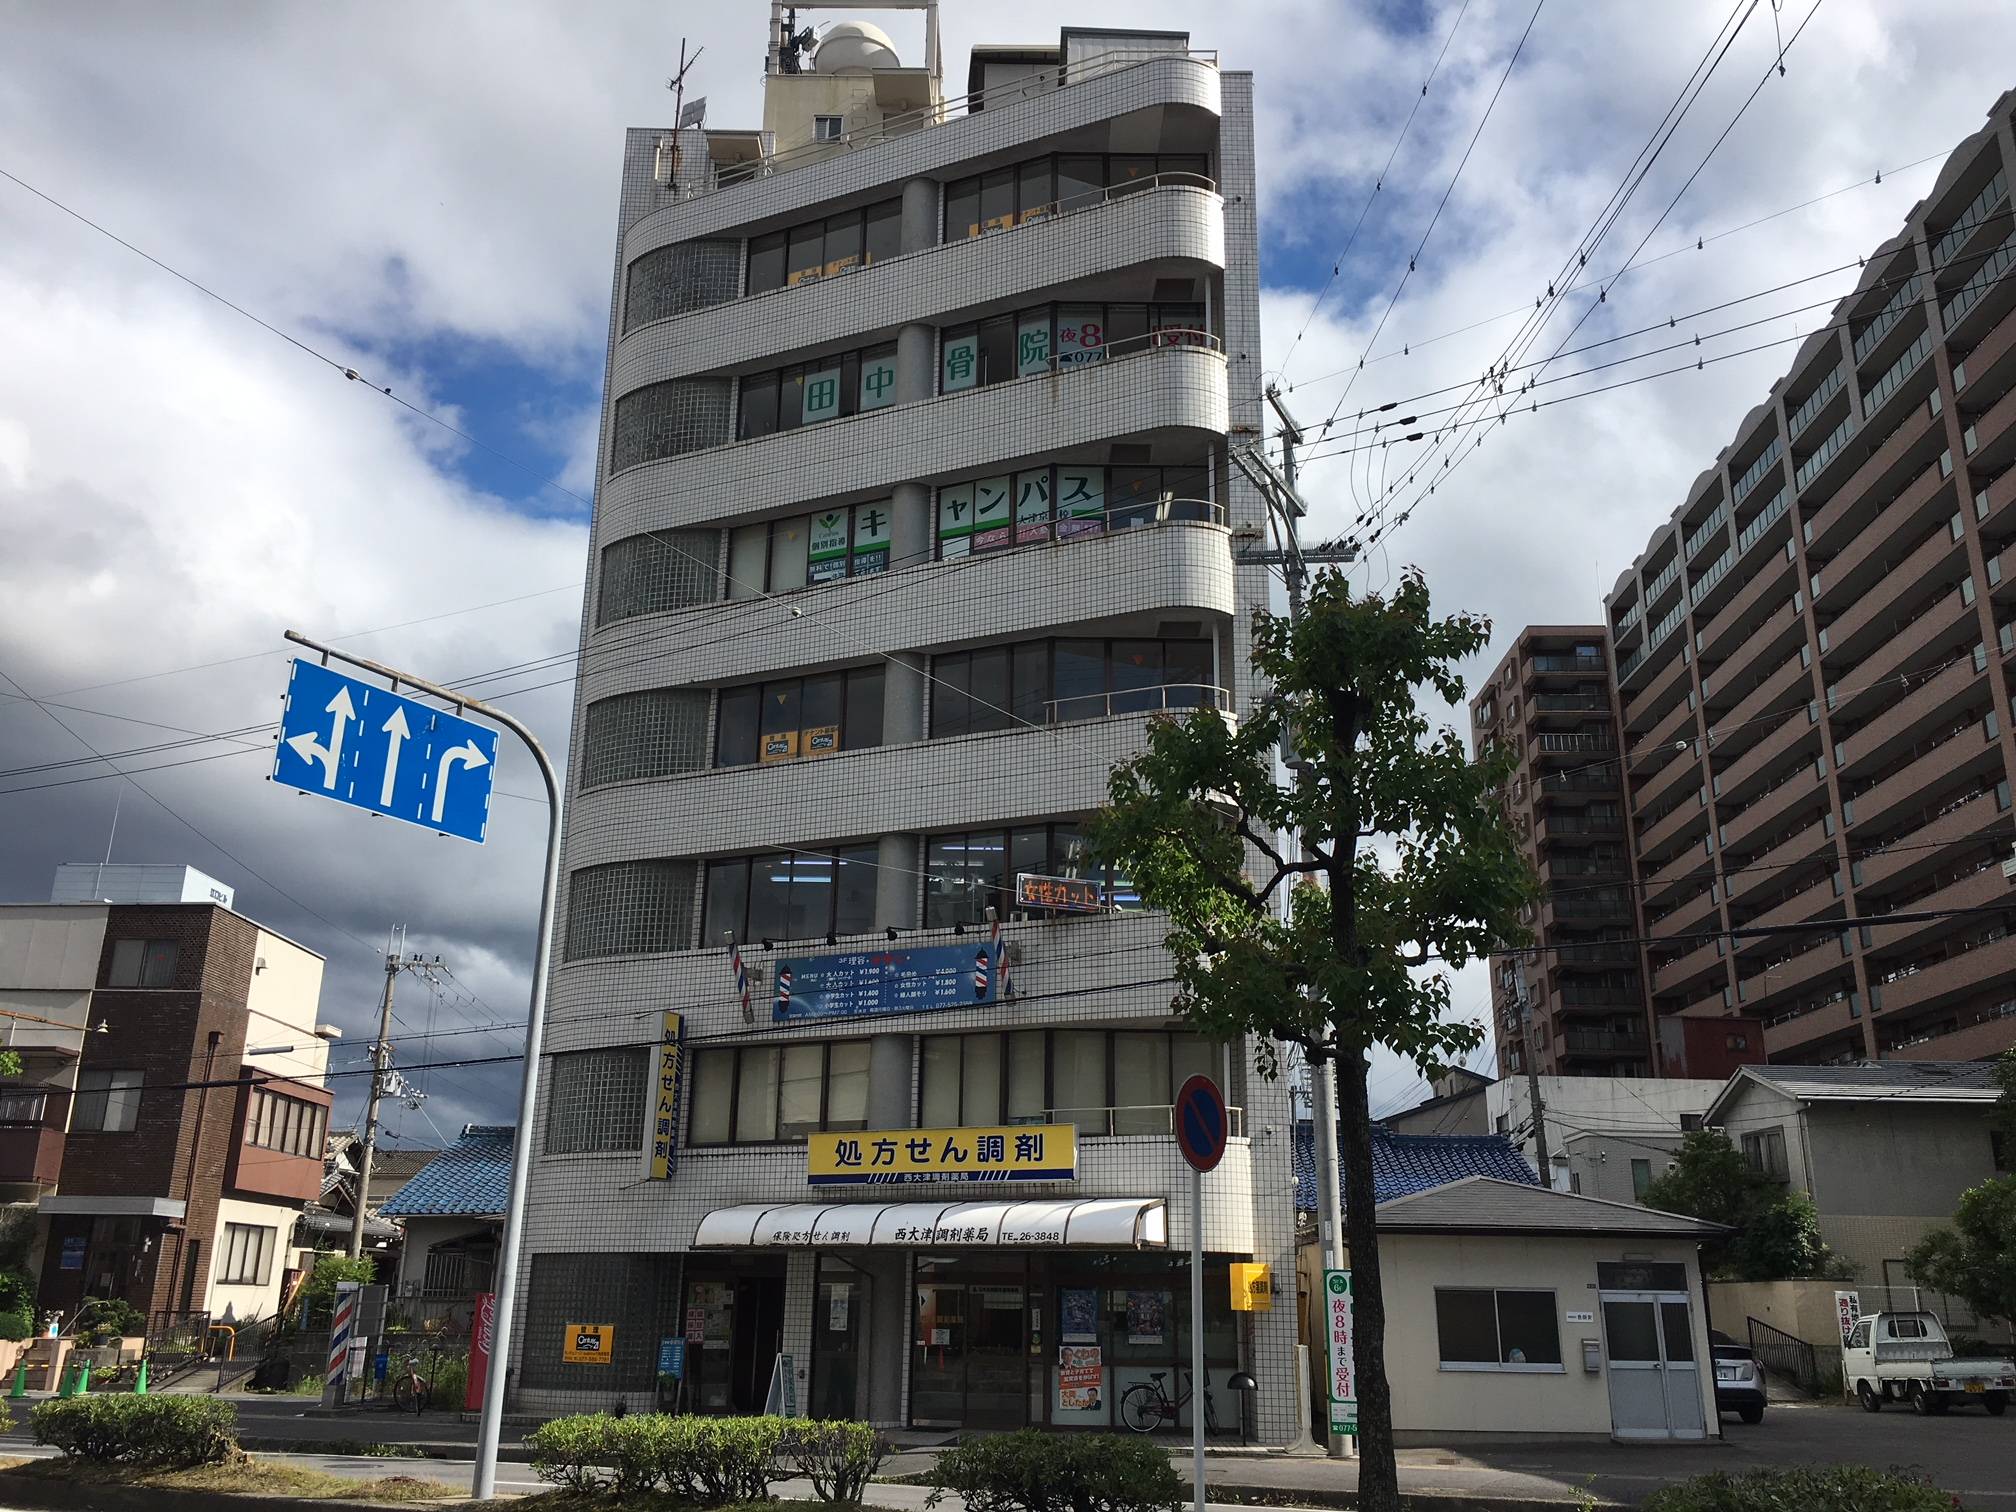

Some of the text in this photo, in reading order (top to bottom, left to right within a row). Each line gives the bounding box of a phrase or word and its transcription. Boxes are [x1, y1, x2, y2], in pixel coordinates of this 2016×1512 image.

[812, 537, 846, 551] 個別指導
[1023, 880, 1095, 904] 女性カット
[826, 969, 855, 978] 大人カット
[825, 980, 855, 988] 大人カット
[900, 981, 927, 989] 女性カット
[654, 1029, 678, 1159] 処方せん調剤
[834, 1133, 1044, 1167] 処方せん調剤
[903, 1172, 969, 1182] 西大津調剤薬局
[894, 1226, 989, 1243] 西大津調剤薬局
[1019, 1231, 1060, 1241] 26-3848
[1332, 1299, 1350, 1397] 夜8時まで受付
